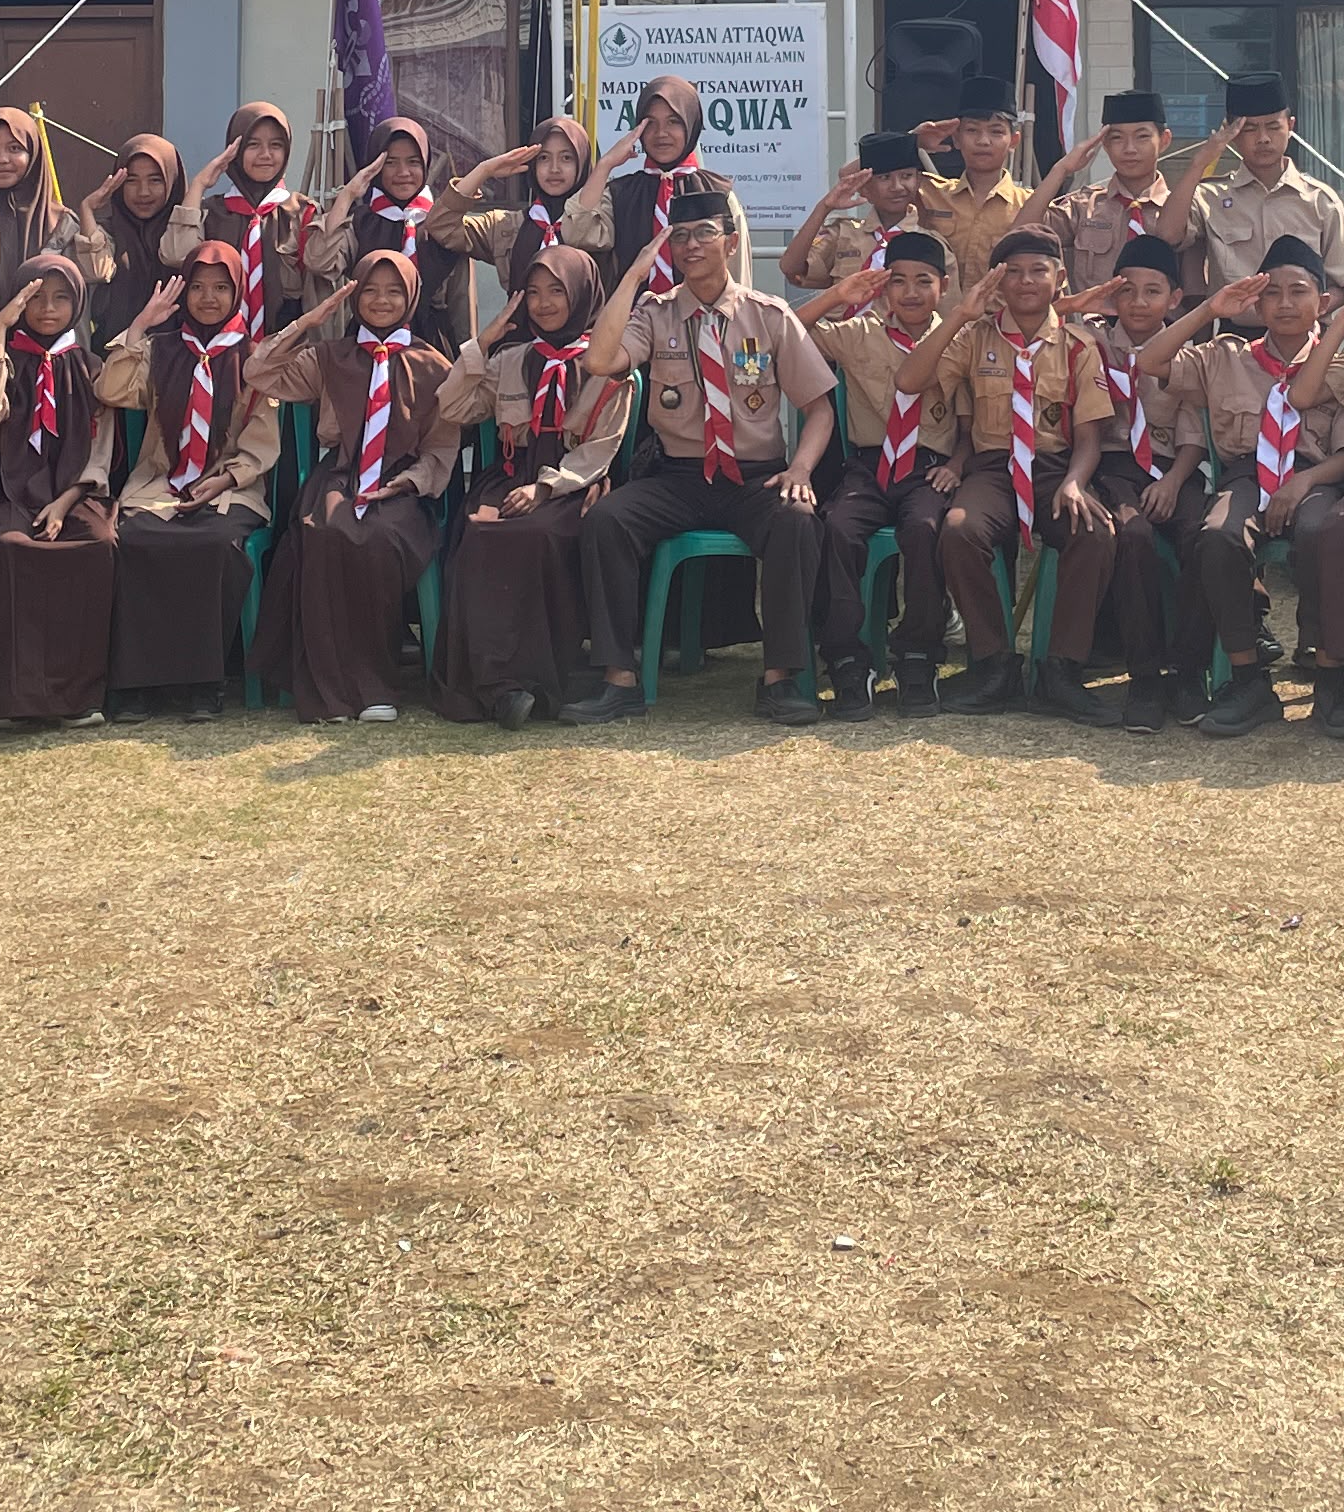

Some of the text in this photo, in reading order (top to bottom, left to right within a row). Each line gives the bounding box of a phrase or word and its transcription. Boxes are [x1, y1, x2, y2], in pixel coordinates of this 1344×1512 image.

[645, 26, 805, 47] YAYASAN ATTAQWA
[645, 51, 753, 66] MADINATUNNAJAH
[755, 50, 805, 64] AL-AMIN
[698, 79, 804, 94] TSANAWIYAH
[764, 142, 782, 154] "A"
